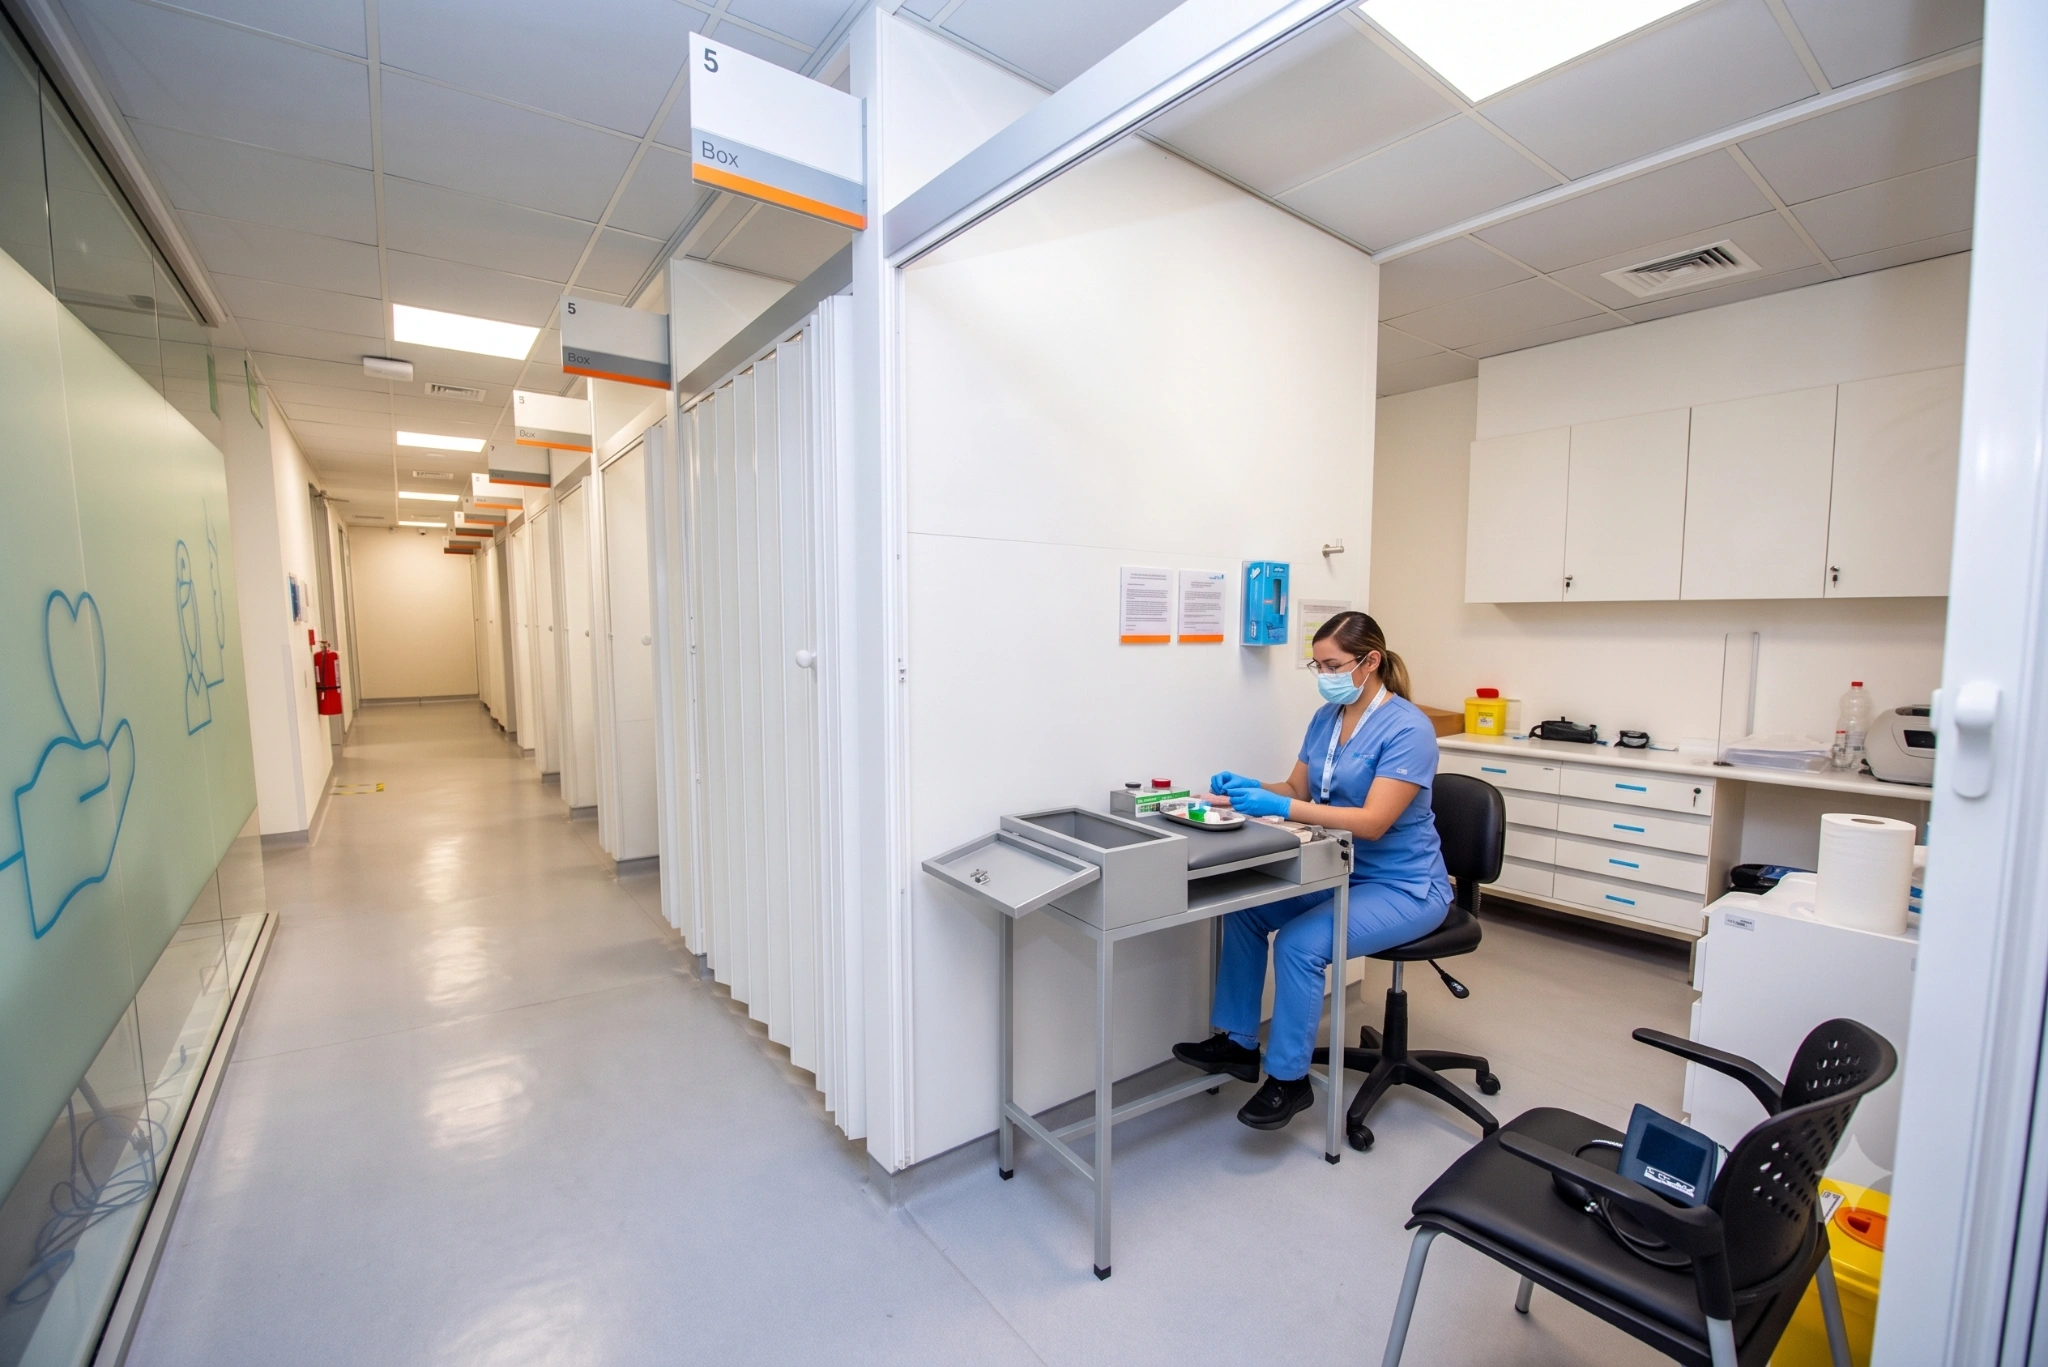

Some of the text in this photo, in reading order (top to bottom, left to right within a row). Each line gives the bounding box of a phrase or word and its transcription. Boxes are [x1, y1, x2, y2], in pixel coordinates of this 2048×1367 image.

[704, 48, 719, 73] 5
[702, 141, 739, 168] Box
[568, 302, 576, 314] 5
[568, 353, 590, 364] Box
